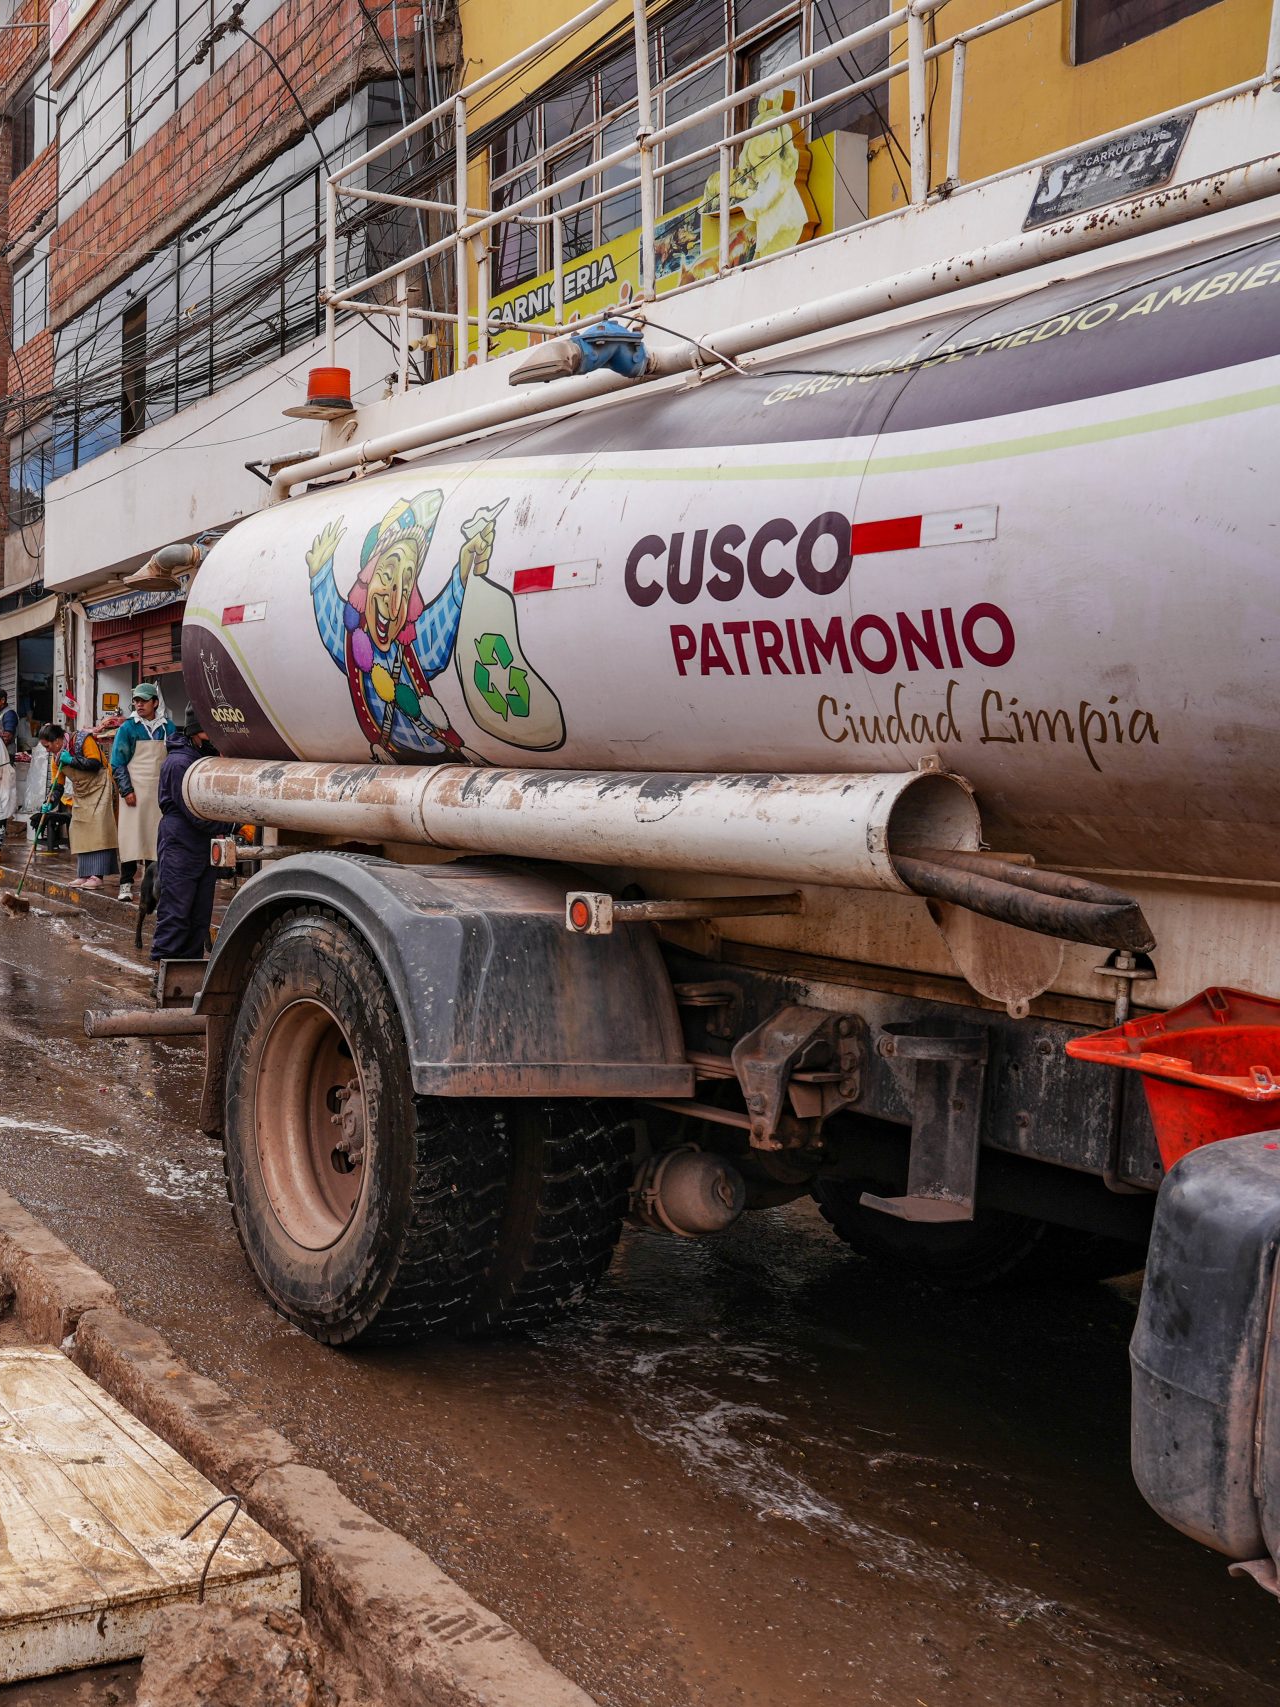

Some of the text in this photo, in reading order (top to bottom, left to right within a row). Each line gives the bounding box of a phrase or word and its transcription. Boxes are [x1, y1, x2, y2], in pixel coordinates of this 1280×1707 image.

[763, 260, 1280, 405] GERENCIA DE MEDIO AMBIE
[624, 511, 854, 607] CUSCO
[669, 602, 1016, 677] PATRIMONIO
[211, 708, 245, 722] QOSQO
[817, 679, 1160, 773] Ciudad Limpia
